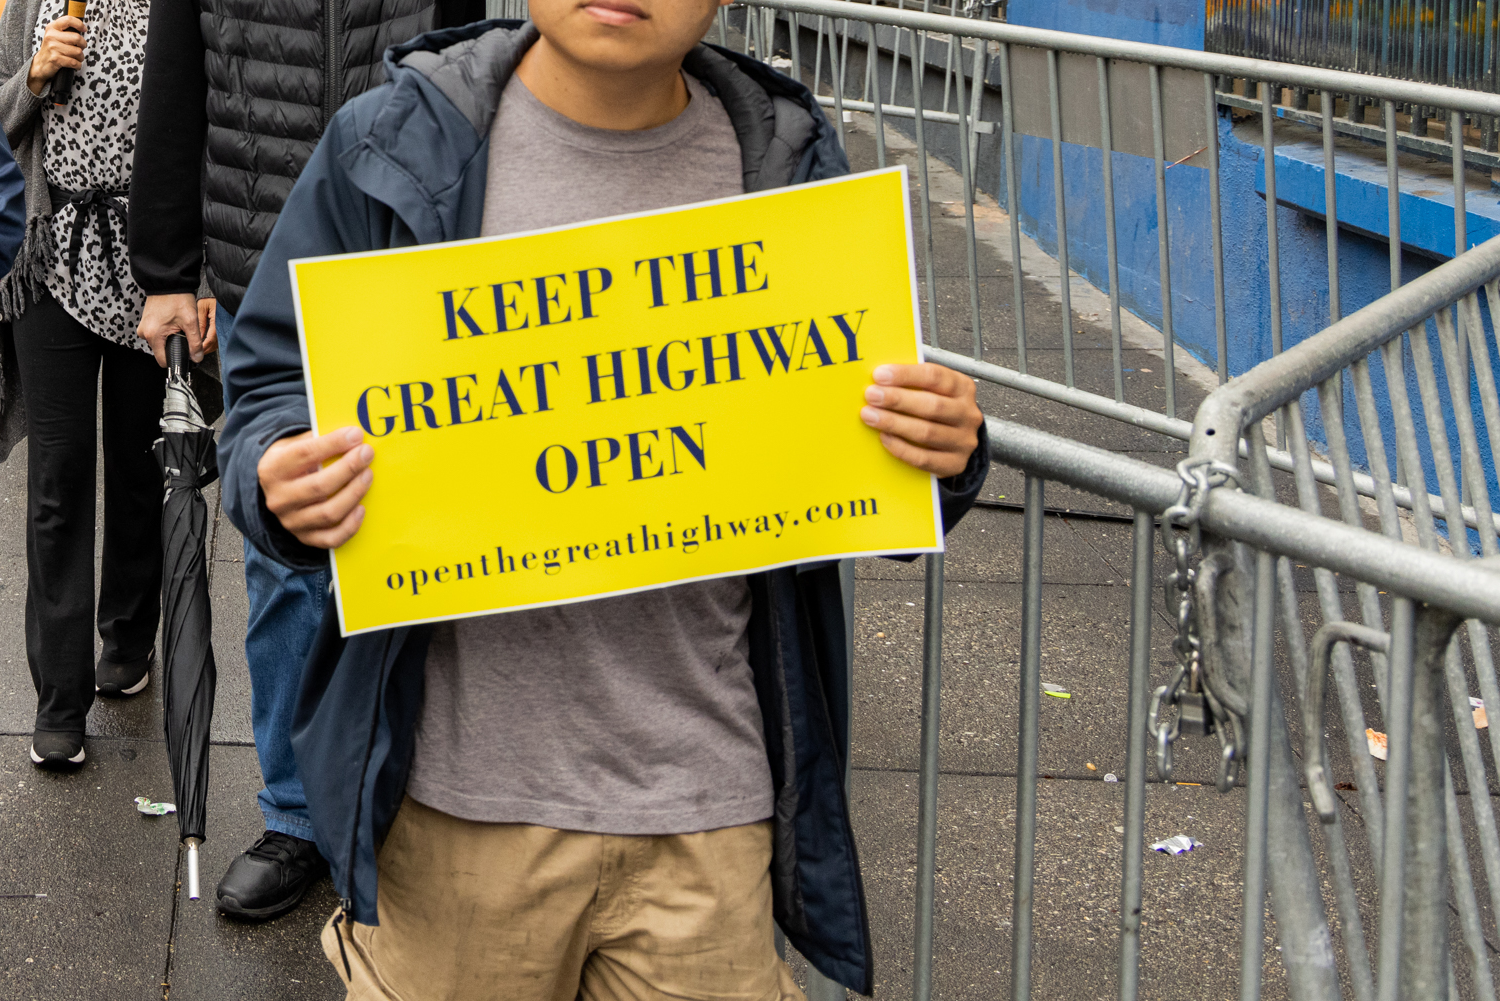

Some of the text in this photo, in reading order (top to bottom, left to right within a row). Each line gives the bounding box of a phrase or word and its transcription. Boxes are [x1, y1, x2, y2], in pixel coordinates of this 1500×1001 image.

[438, 240, 770, 342] KEEP THE
[355, 308, 870, 438] GREAT HIGHWAY
[534, 421, 707, 495] OPEN
[385, 493, 881, 597] openthegreathighway.com
